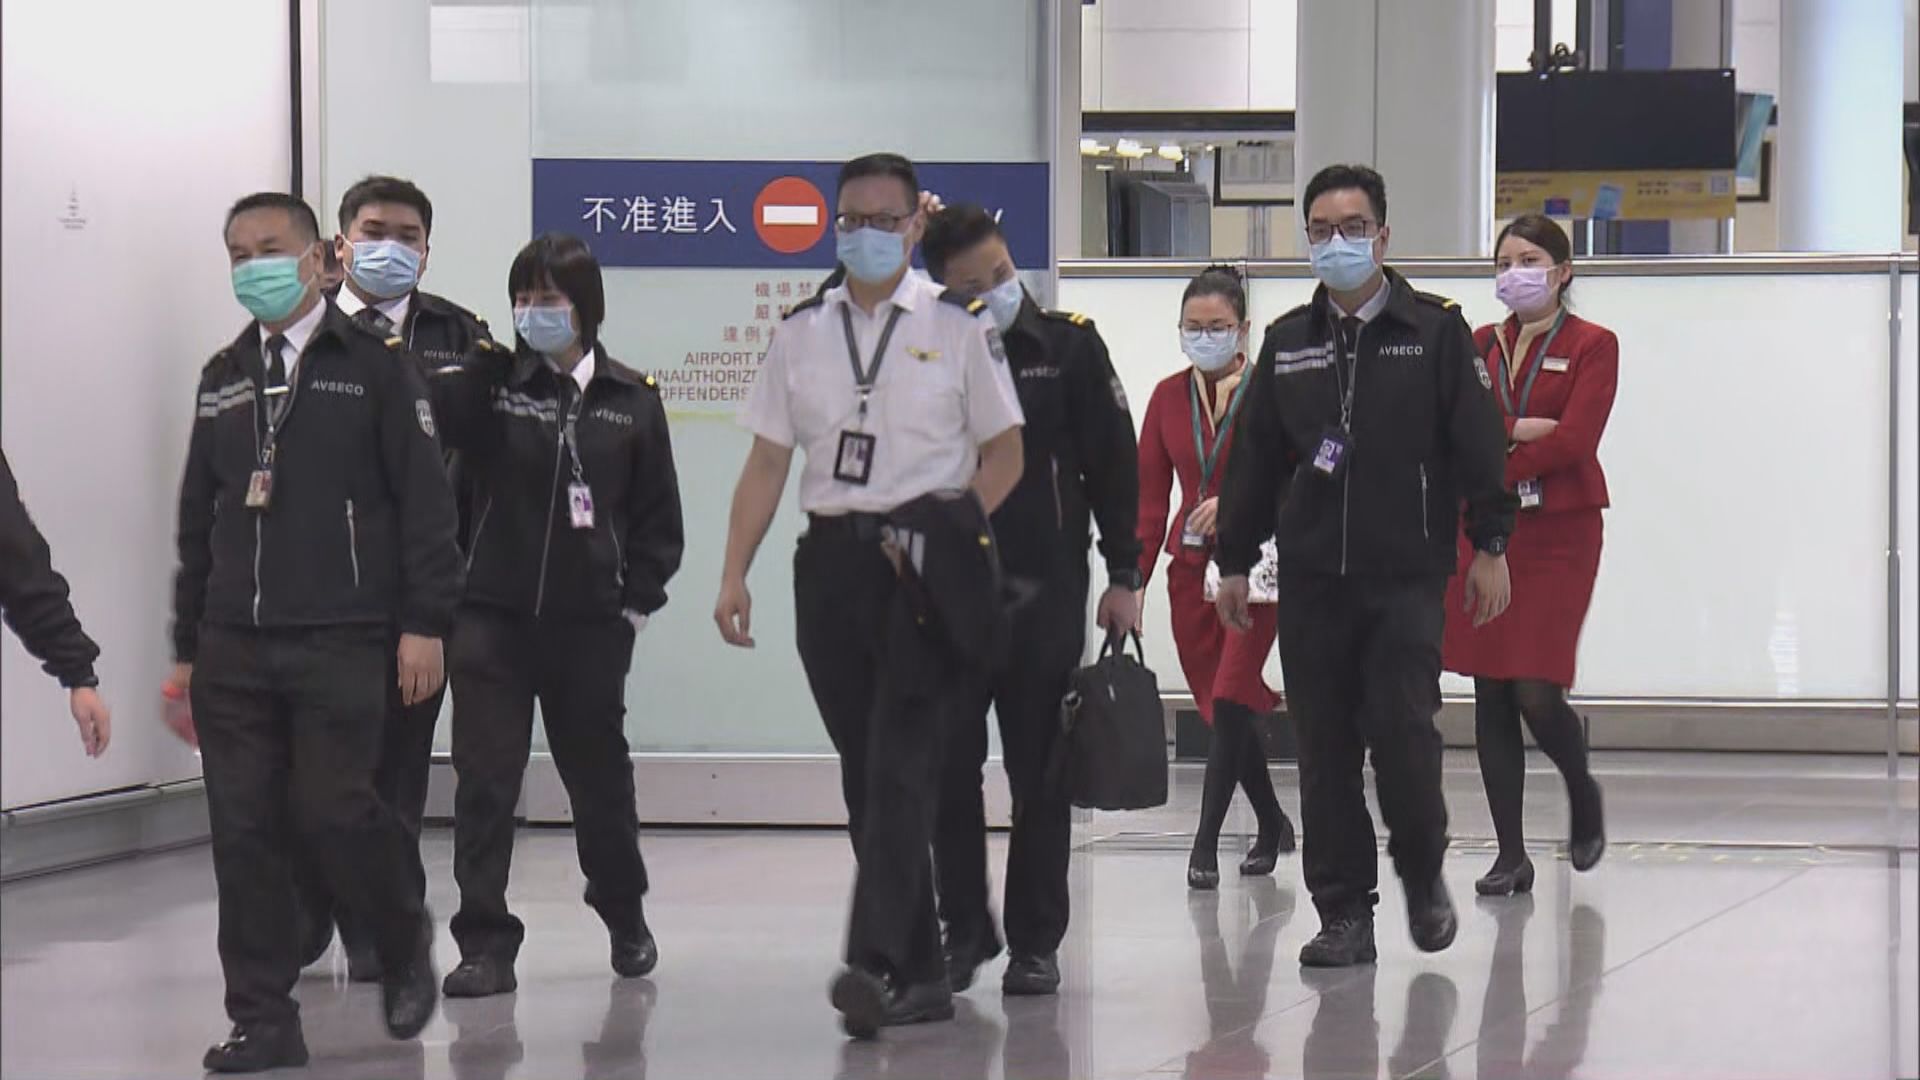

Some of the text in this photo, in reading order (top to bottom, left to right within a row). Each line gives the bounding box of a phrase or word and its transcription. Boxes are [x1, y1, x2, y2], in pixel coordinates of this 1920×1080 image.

[582, 196, 737, 233] 不准進入
[755, 281, 821, 297] 機場禁
[1378, 345, 1423, 356] AVSECO
[683, 351, 753, 366] AIRPORT
[311, 379, 364, 396] AVSECO
[659, 386, 749, 401] OFFENDERS
